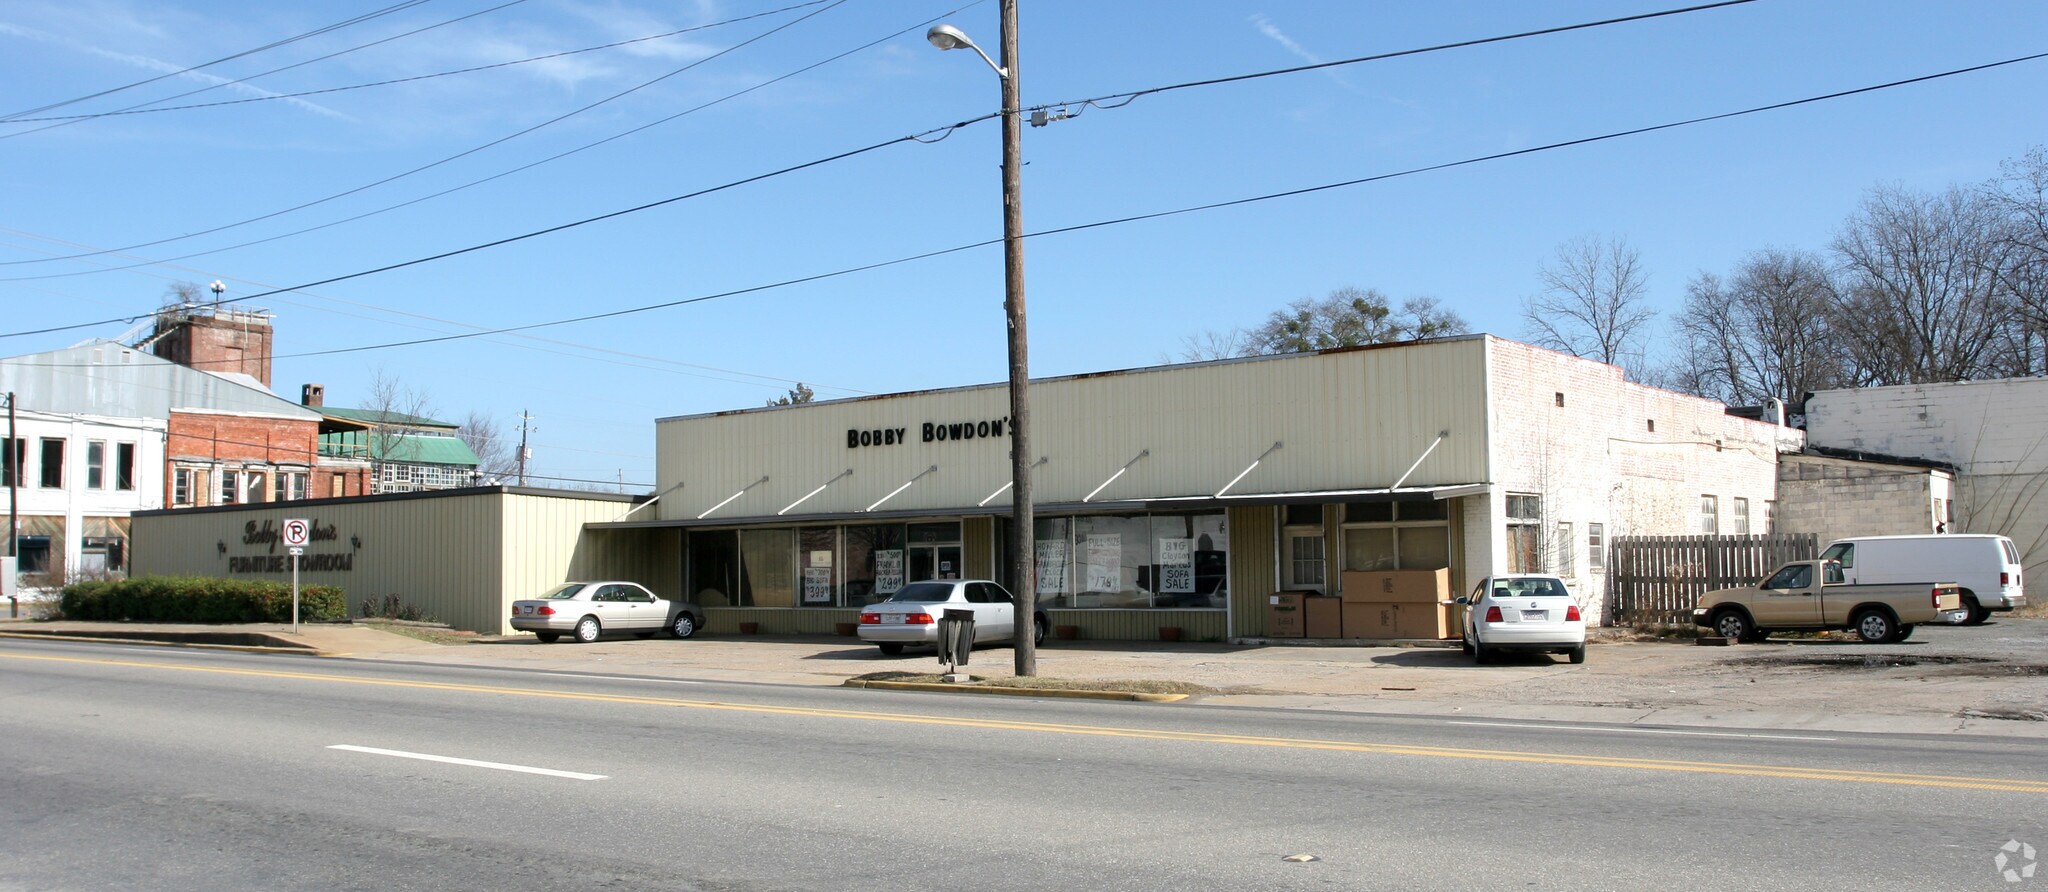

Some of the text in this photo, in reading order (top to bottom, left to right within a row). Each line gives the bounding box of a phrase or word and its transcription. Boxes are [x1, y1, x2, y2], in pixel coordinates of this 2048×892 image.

[847, 428, 905, 448] BOBBY
[242, 519, 278, 554] Bobby
[1161, 552, 1190, 561] Clayton
[229, 555, 284, 573] FURNITURE
[1167, 569, 1189, 578] SOFA
[1041, 577, 1064, 589] SALE
[1165, 578, 1189, 589] SALE
